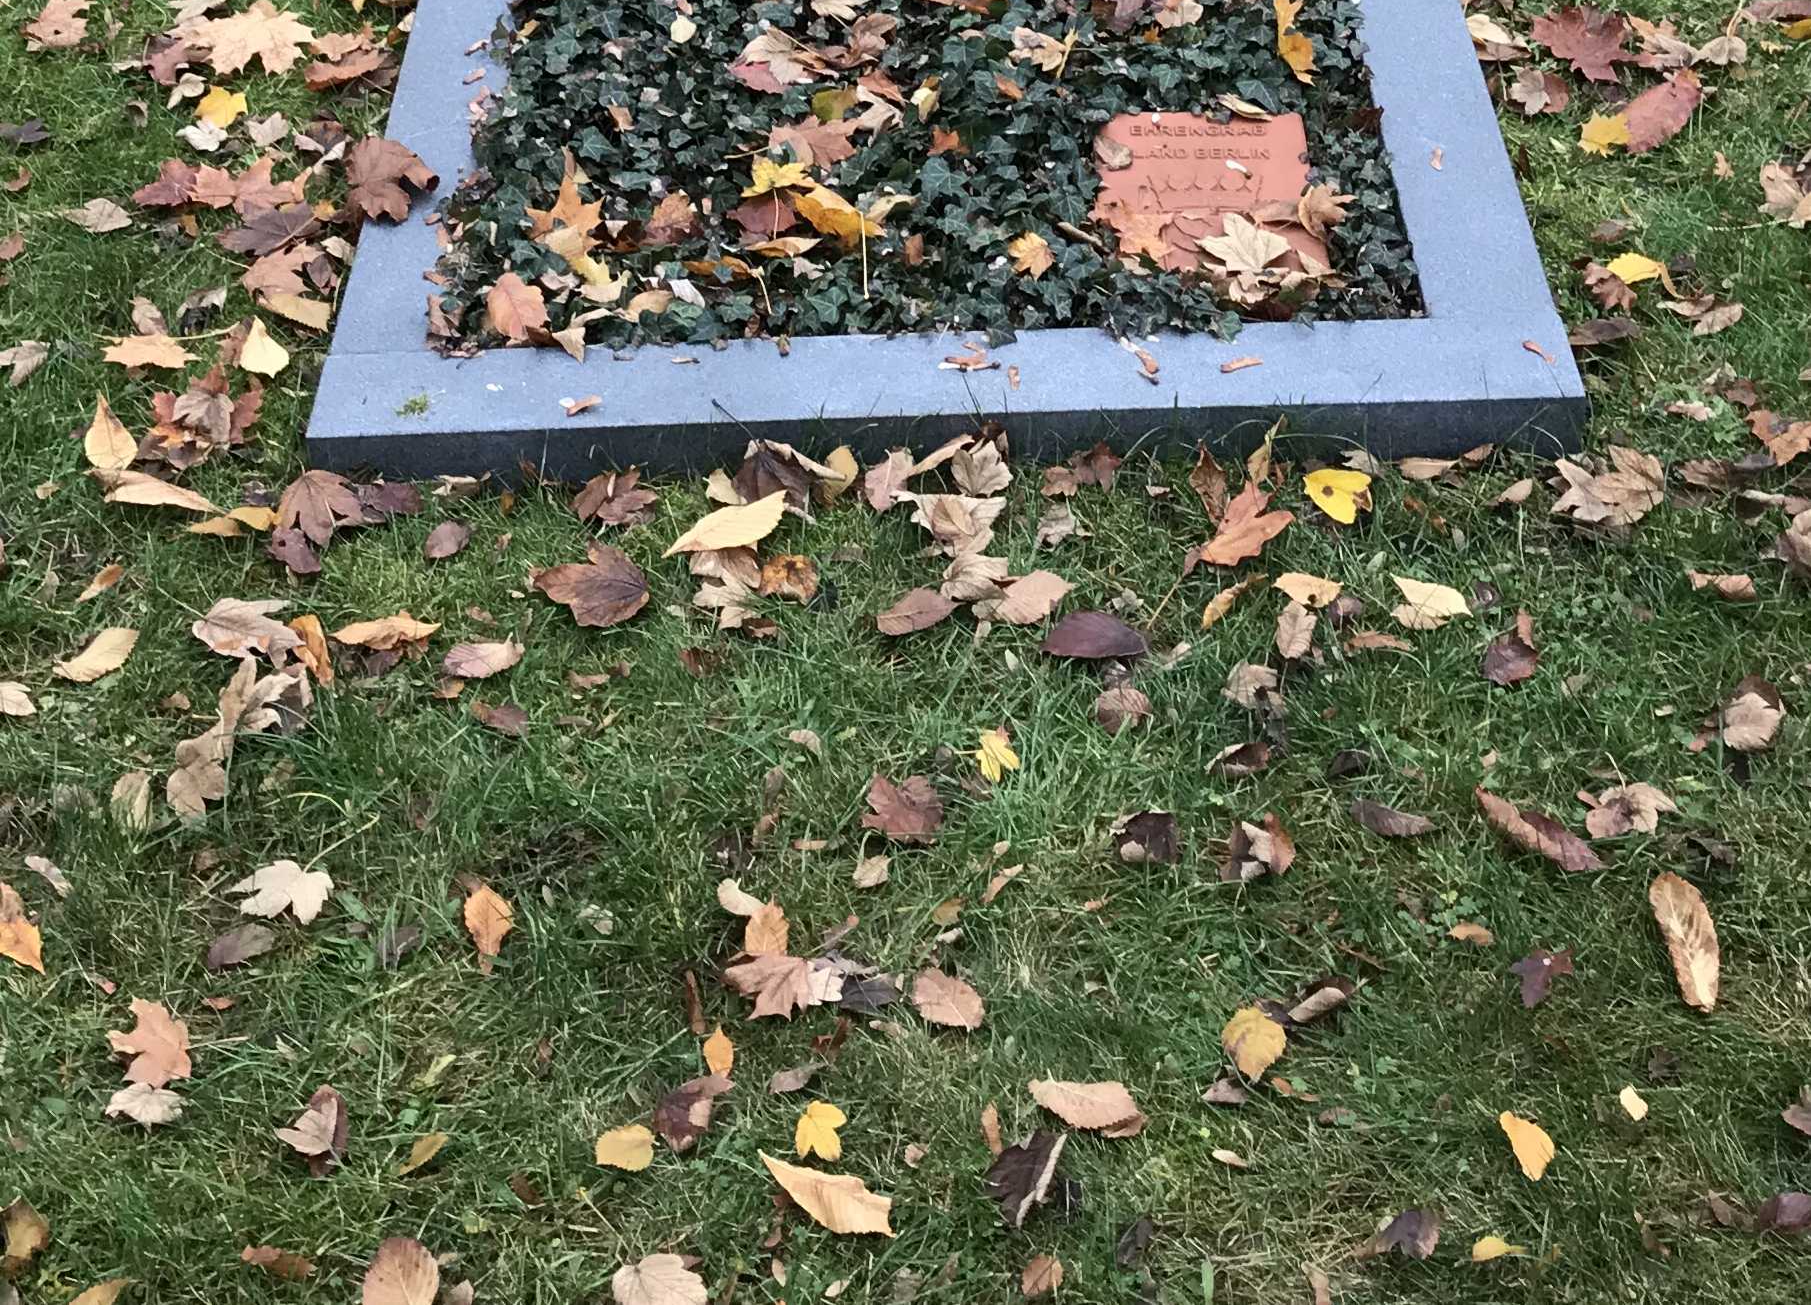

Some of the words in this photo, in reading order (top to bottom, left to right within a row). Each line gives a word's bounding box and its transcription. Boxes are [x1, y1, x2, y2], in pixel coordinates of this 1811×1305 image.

[1129, 124, 1268, 138] EHRENGRAB
[1131, 147, 1189, 160] LAND
[1193, 147, 1271, 160] BERLIN
